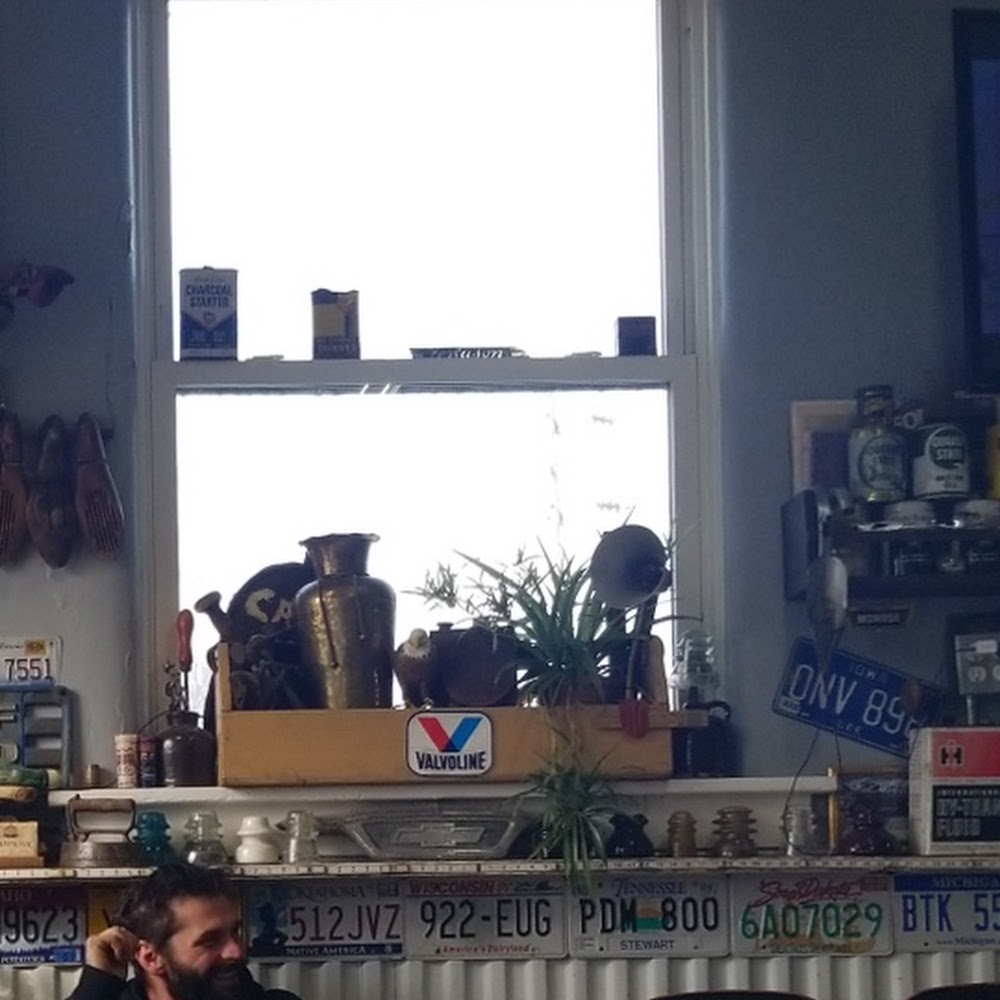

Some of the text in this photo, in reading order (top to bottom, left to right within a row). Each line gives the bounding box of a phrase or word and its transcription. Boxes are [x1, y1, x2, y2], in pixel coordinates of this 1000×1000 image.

[4, 658, 53, 681] 7551
[416, 751, 486, 771] VALVOLINE
[290, 904, 401, 942] 512JVZ
[420, 899, 552, 939] 922-EUG
[579, 896, 719, 934] PDM 800
[741, 902, 883, 940] 6A07029
[902, 894, 954, 933] BTK
[323, 944, 367, 956] AMERICA
[620, 938, 675, 951] STEWART
